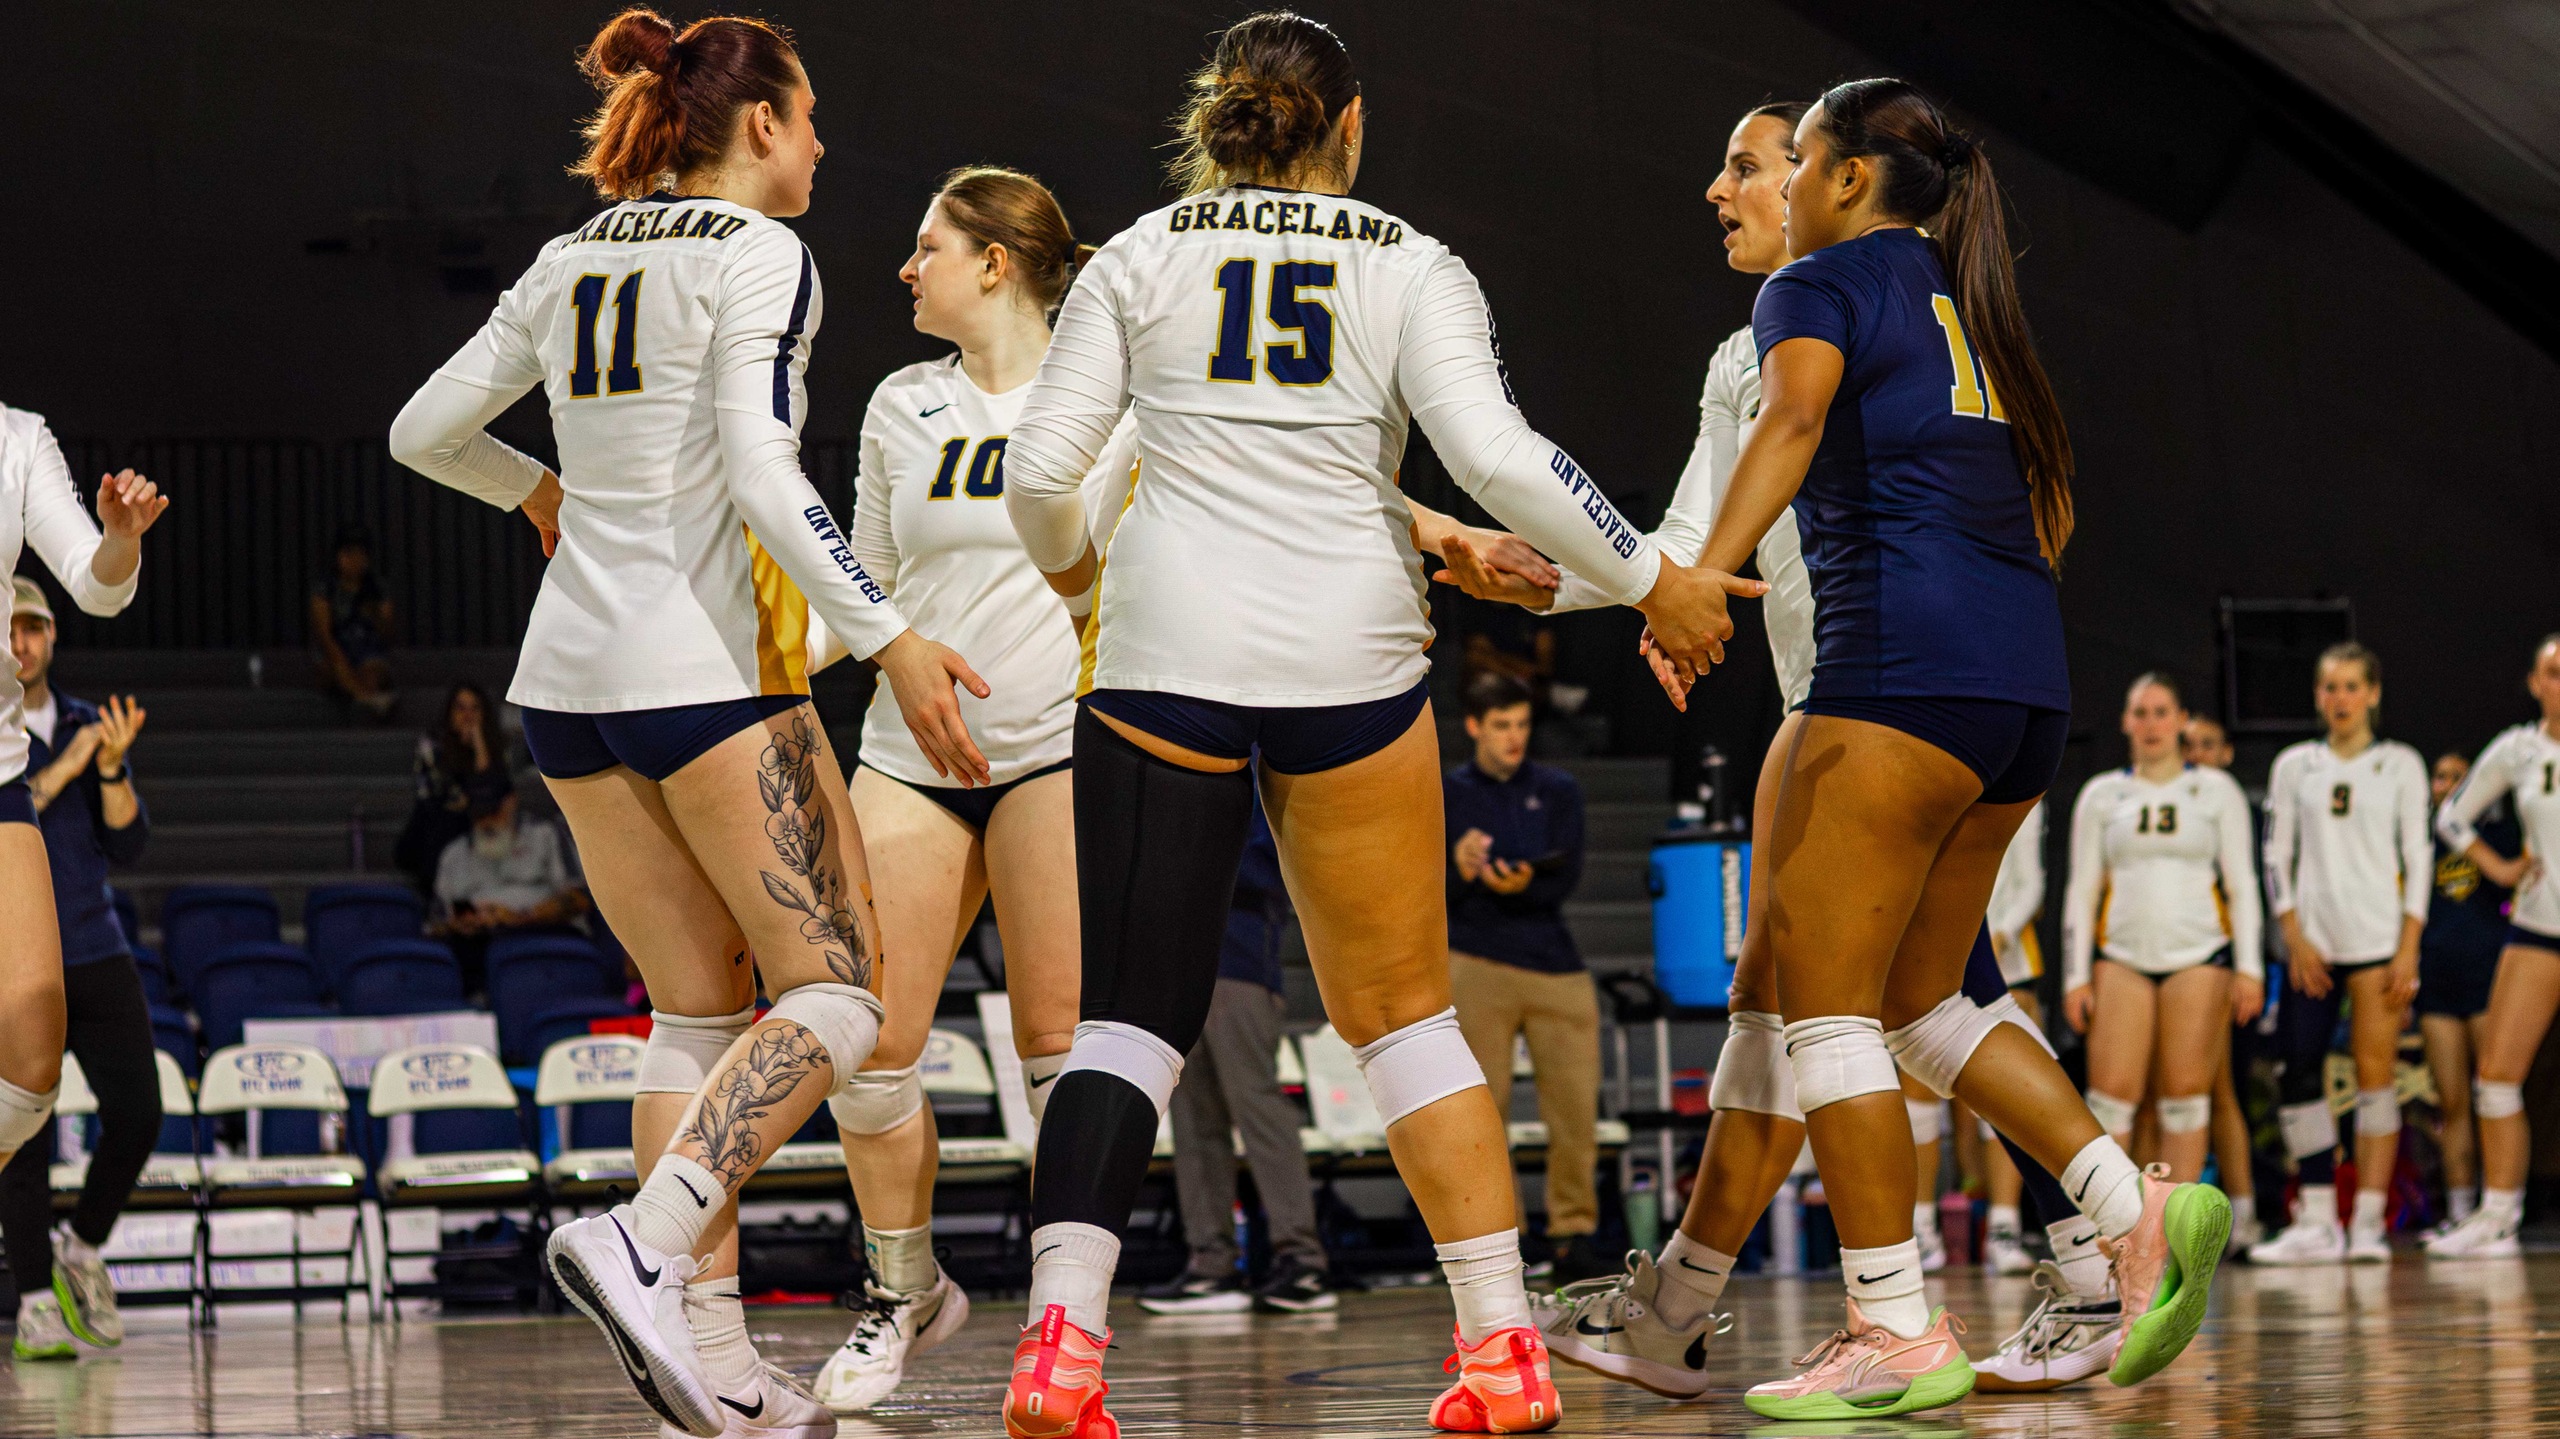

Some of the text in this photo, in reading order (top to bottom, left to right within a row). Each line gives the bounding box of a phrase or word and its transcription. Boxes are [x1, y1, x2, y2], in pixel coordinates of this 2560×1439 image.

[1169, 200, 1403, 247] GRACELAND
[568, 268, 646, 399] 11
[1207, 257, 1338, 387] 15
[927, 434, 1009, 501] 10
[1550, 449, 1638, 560] GRACELAND
[803, 505, 888, 604] GRACELAND
[2136, 804, 2178, 834] 13
